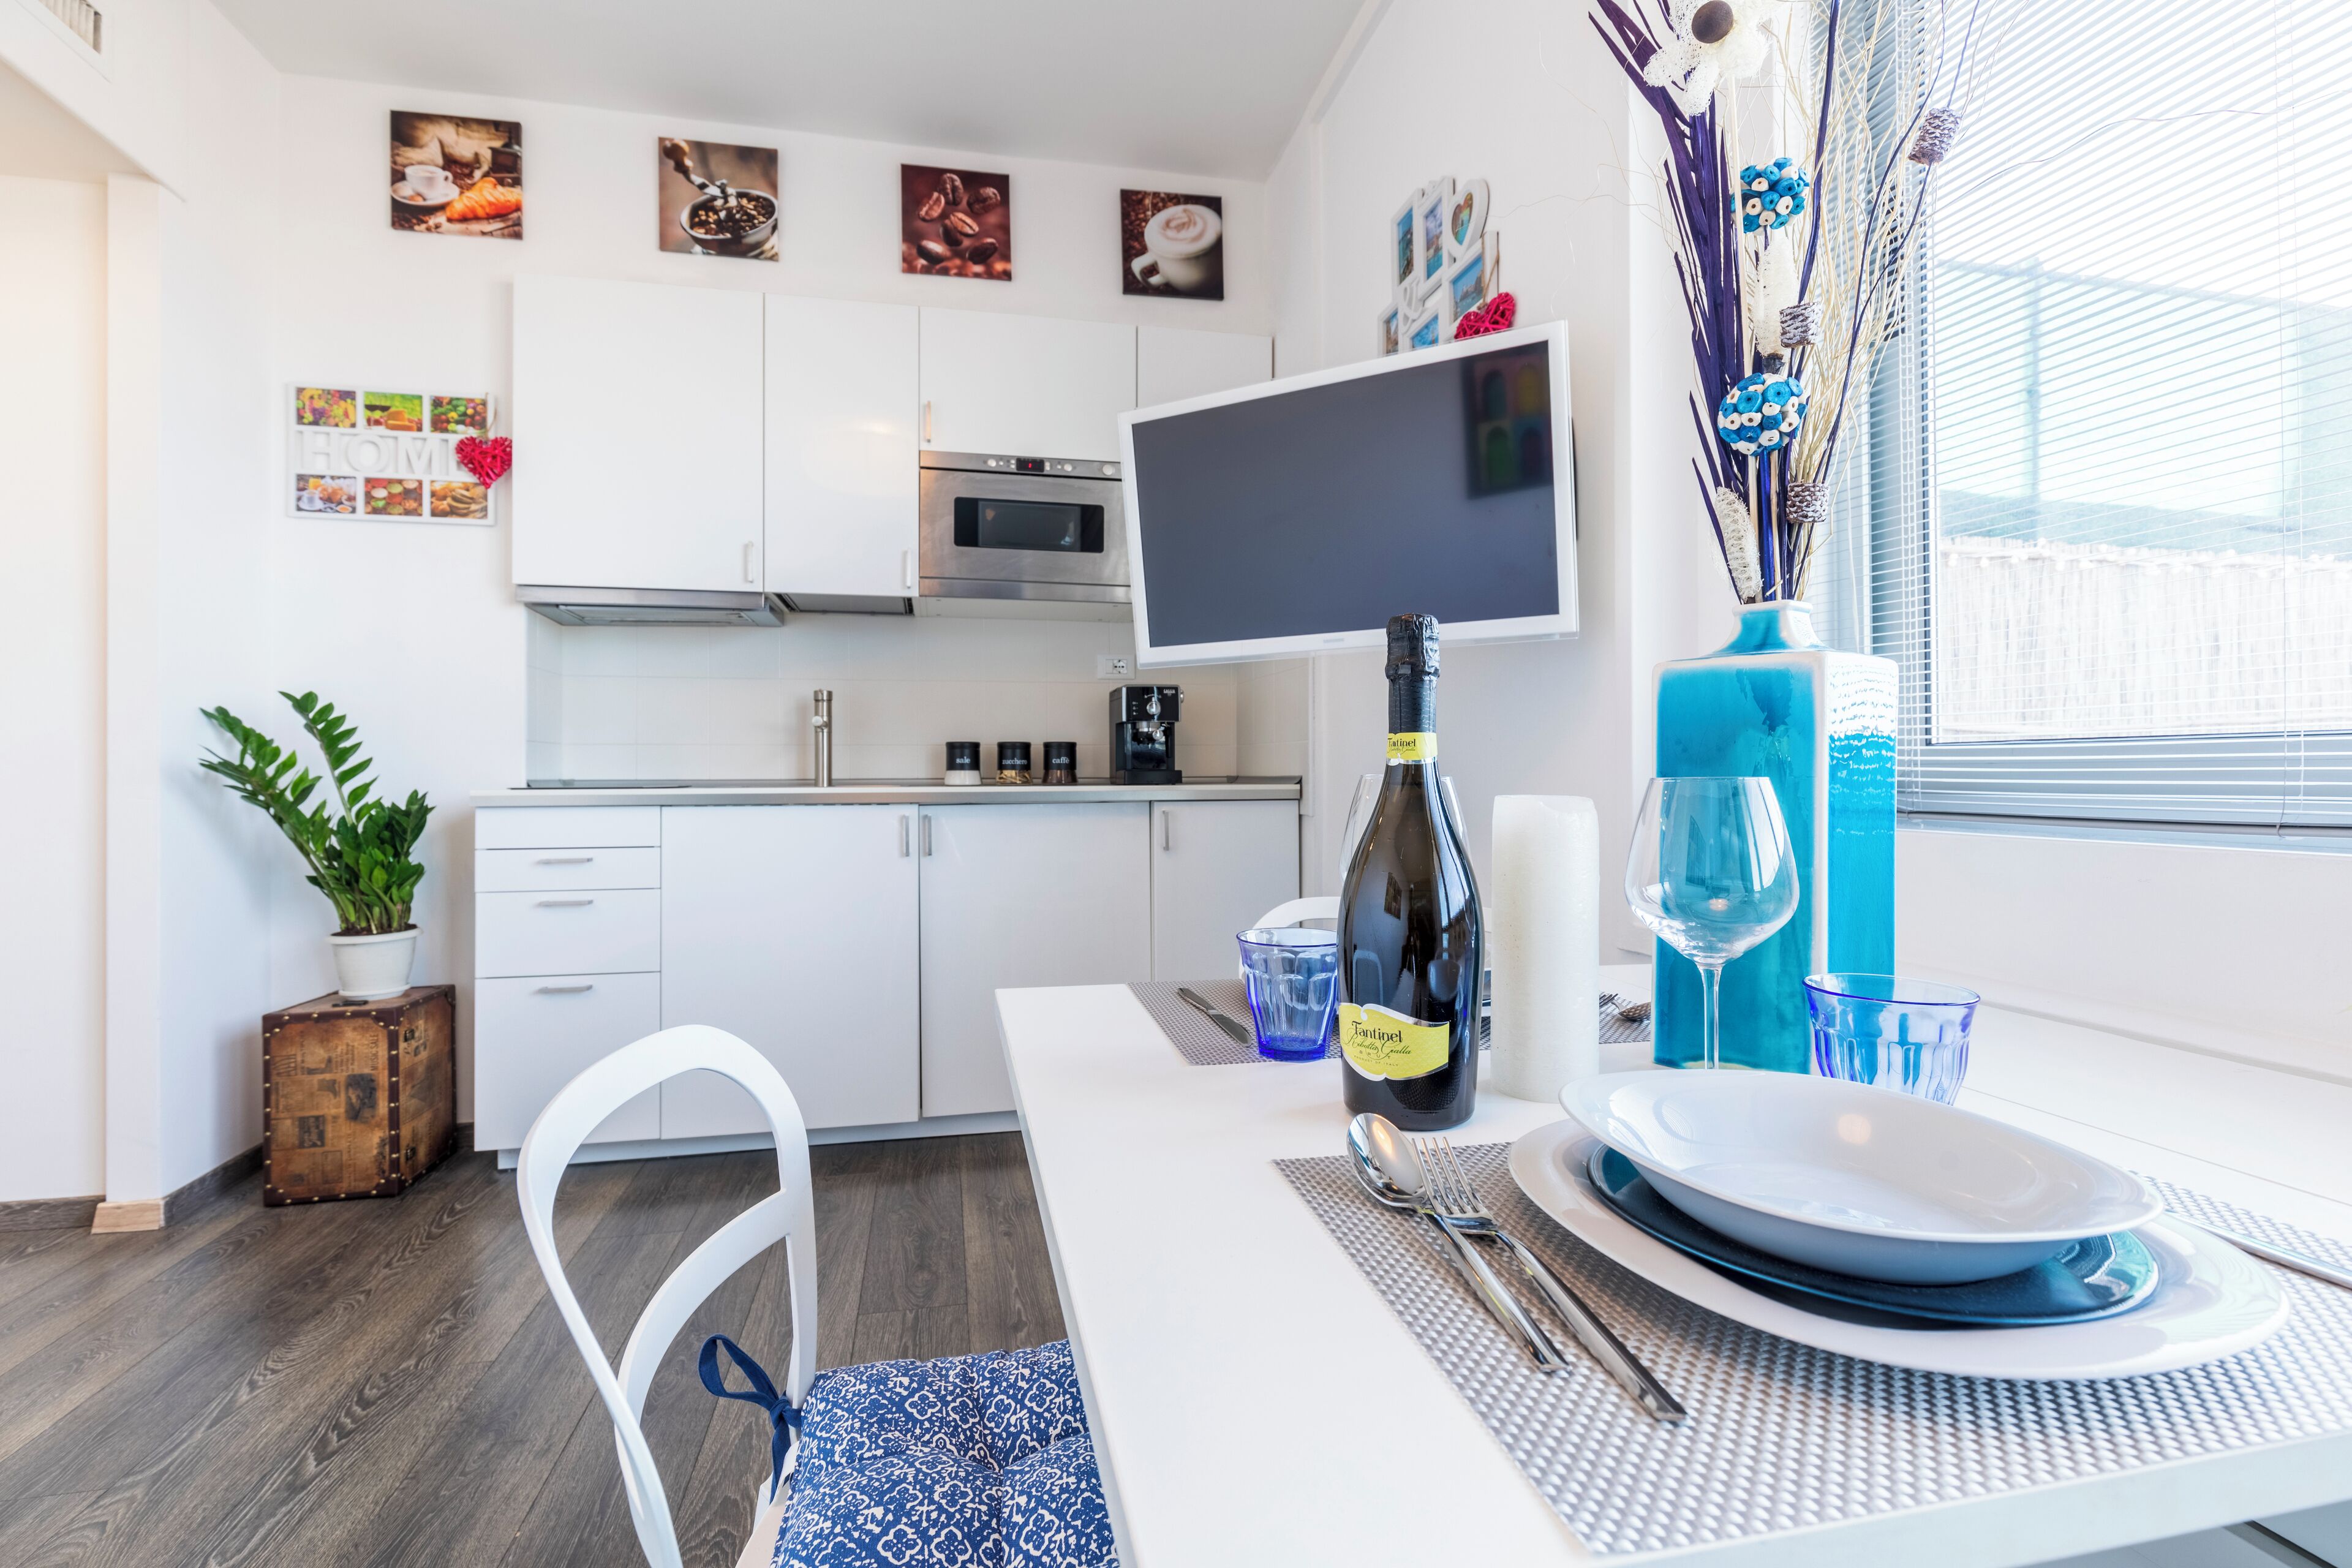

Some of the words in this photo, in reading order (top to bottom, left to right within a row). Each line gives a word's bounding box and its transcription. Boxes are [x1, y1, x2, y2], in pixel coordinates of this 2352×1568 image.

[1352, 1020, 1402, 1042] Fantinel
[370, 1034, 379, 1050] SALE
[370, 1051, 379, 1071] MUSIC
